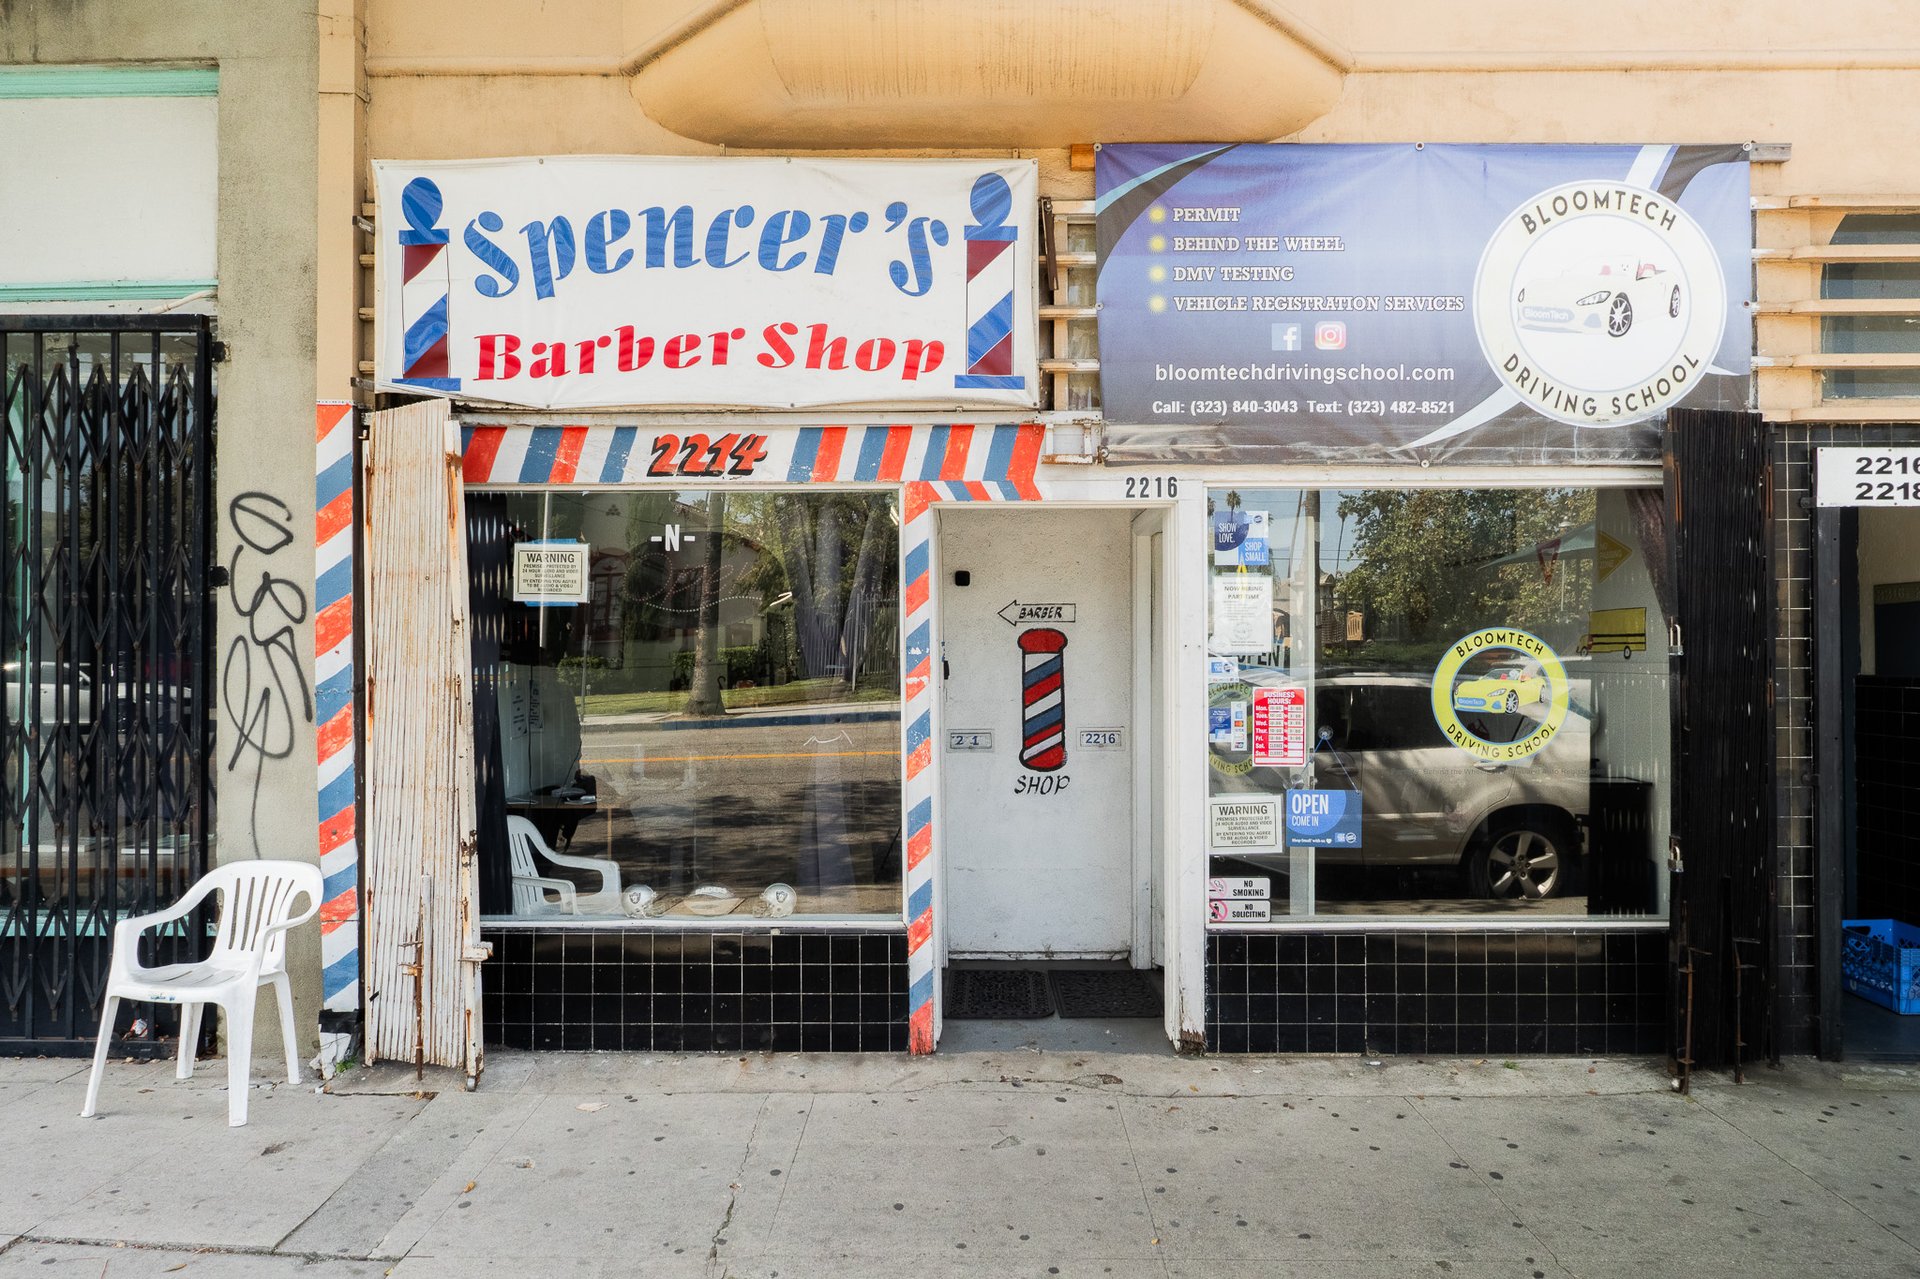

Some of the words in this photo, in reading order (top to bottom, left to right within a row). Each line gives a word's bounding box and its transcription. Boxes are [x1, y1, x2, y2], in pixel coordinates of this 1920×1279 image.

[1172, 207, 1241, 222] PERMIT
[1520, 190, 1677, 235] BLOOMTECH
[463, 201, 950, 301] Spencer's
[1173, 236, 1240, 252] BEHIND
[1244, 236, 1279, 252] THE
[1283, 236, 1345, 252] WHEEL
[1173, 266, 1216, 281] DMV
[1220, 266, 1294, 281] TESTING
[1173, 296, 1248, 312] VEHICLE
[1251, 296, 1380, 312] REGISTRATION
[1384, 296, 1465, 312] SERVICES
[1525, 308, 1569, 321] BloomTech
[473, 325, 746, 381] Barber
[756, 322, 945, 381] Shop
[1155, 363, 1455, 385] bloomtechdrivingschool.com
[1503, 353, 1597, 416] DRIVING
[1611, 354, 1699, 416] SCHOOL
[1152, 400, 1185, 414] Call:
[1190, 400, 1228, 416] (323)
[1232, 400, 1298, 414] 840-3043
[1307, 400, 1342, 414] Text:
[1347, 400, 1386, 416] (323)
[1390, 400, 1455, 414] 482-8521
[647, 432, 768, 477] 2214
[1126, 476, 1178, 499] 2216
[1218, 522, 1238, 533] SHOW
[1219, 533, 1236, 543] LOVE.
[1244, 541, 1262, 552] SHOP
[526, 553, 575, 563] WARNING
[1245, 551, 1266, 562] SMALL
[1018, 606, 1063, 620] BARBER
[1456, 632, 1544, 658] BLOOMTECH
[1208, 682, 1249, 699] BLOOMTEC
[1085, 733, 1116, 744] 2216
[1447, 723, 1500, 758] DRIVING
[1508, 724, 1557, 758] SCHOOL
[1234, 758, 1253, 774] SCHO
[1014, 775, 1070, 795] SHOP
[1218, 805, 1268, 815] WARNING
[1291, 793, 1329, 815] OPEN
[1291, 815, 1311, 827] COME
[1312, 816, 1319, 827] IN
[1232, 889, 1264, 897] SMOKING
